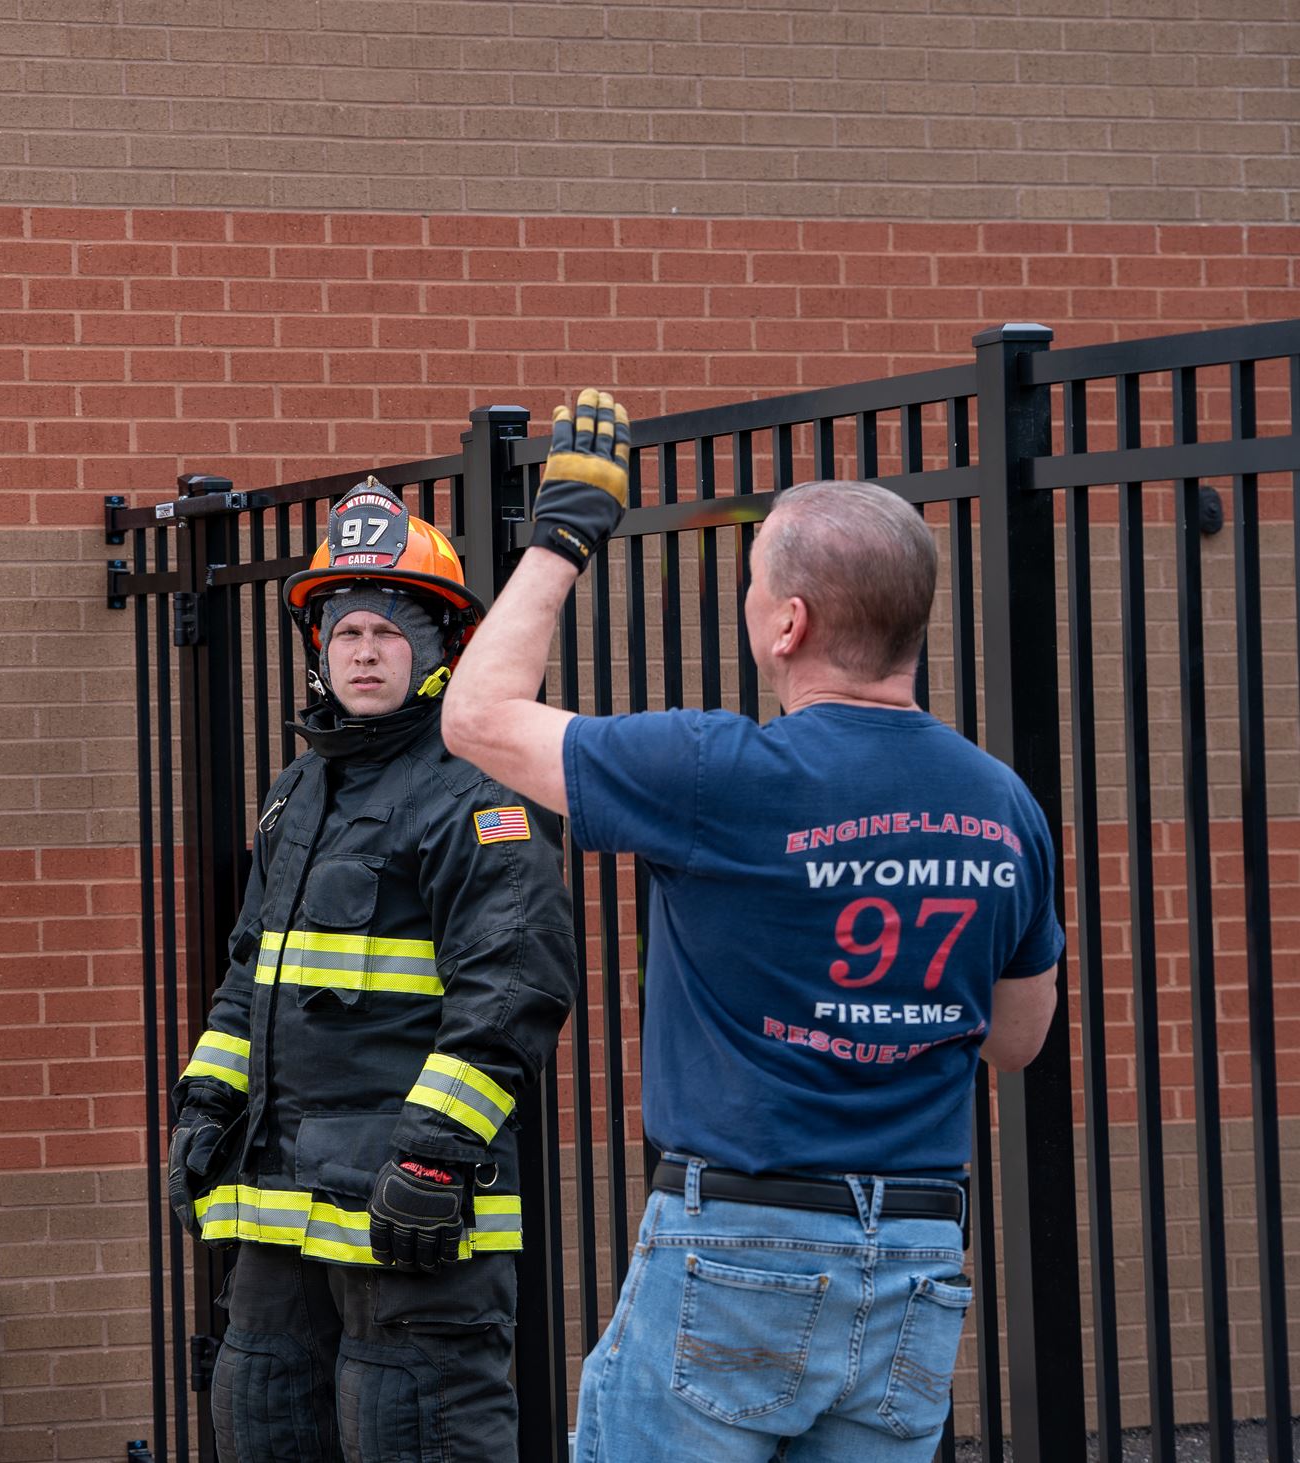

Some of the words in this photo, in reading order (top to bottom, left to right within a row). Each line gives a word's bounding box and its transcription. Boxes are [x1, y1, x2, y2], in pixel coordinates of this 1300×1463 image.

[346, 494, 392, 510] WYOMING
[341, 518, 389, 547] 97
[348, 554, 378, 564] CADET
[805, 859, 1016, 888] WYOMING
[829, 897, 978, 990] 97
[814, 1002, 963, 1024] FIRE-EMS
